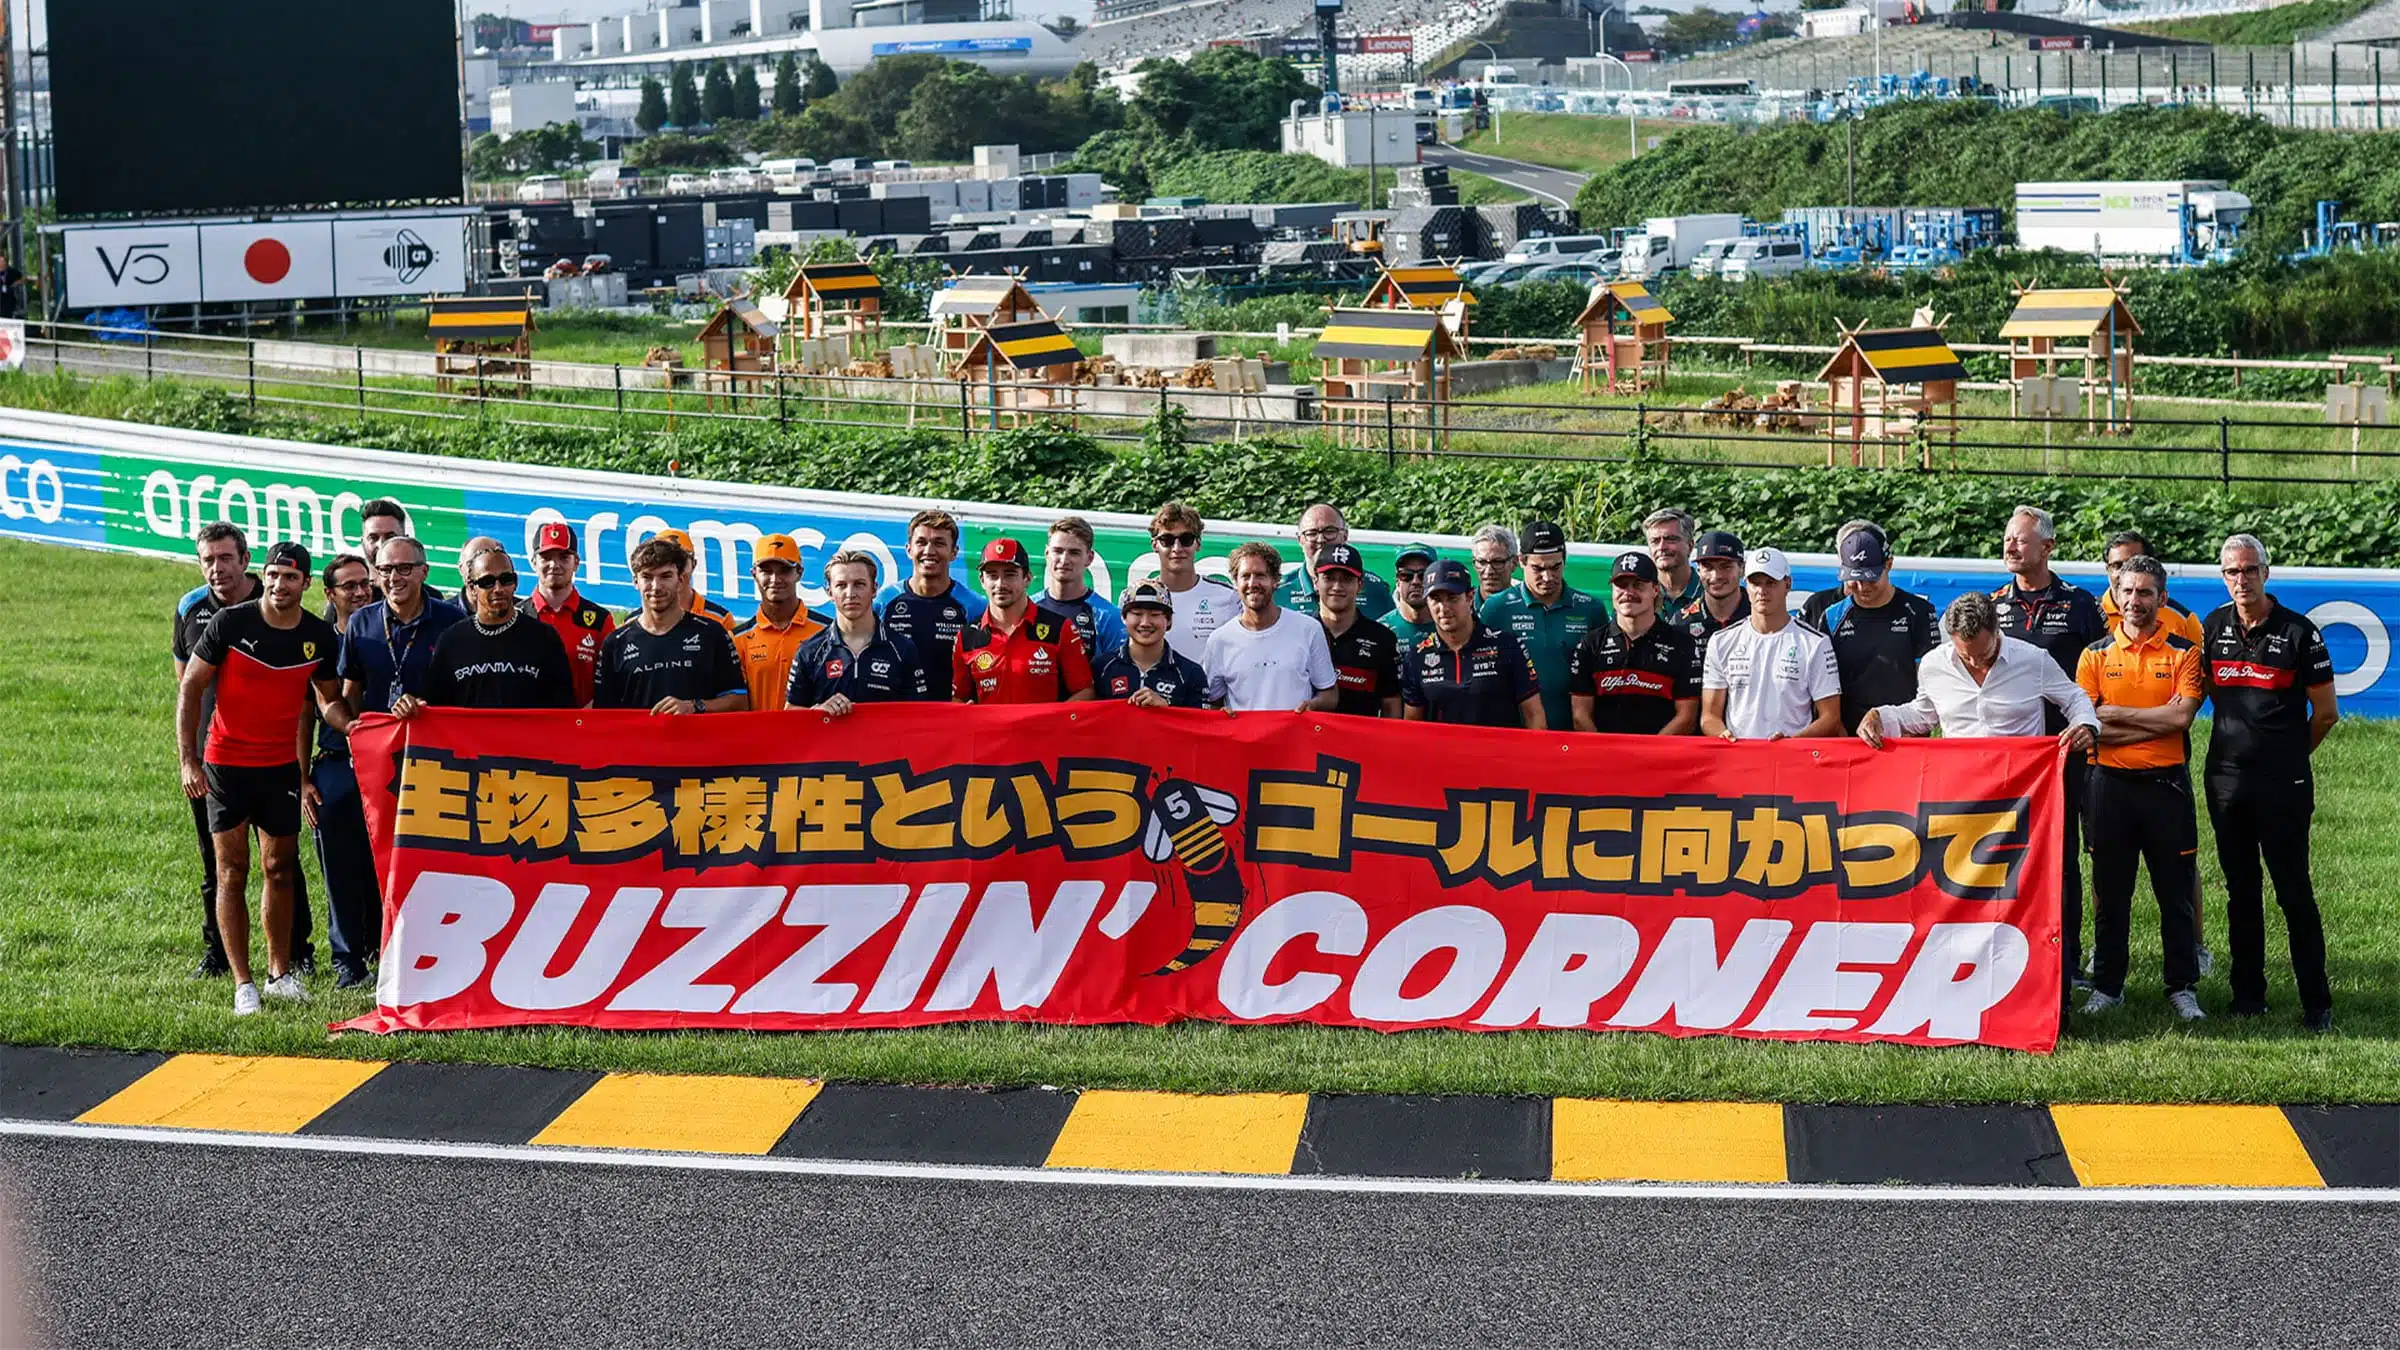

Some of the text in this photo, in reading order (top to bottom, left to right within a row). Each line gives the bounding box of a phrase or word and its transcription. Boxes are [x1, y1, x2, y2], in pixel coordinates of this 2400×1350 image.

[1367, 40, 1412, 51] Lenovo
[2041, 38, 2073, 49] Lenovo
[632, 659, 693, 674] ALPINE
[2217, 665, 2275, 681] Alfa Romeo
[1600, 673, 1664, 692] Alfa Romeo
[1164, 789, 1191, 821] 5
[1255, 768, 2017, 888] ゴールに向かって
[375, 870, 2030, 1041] BUZZIN' CORNER
